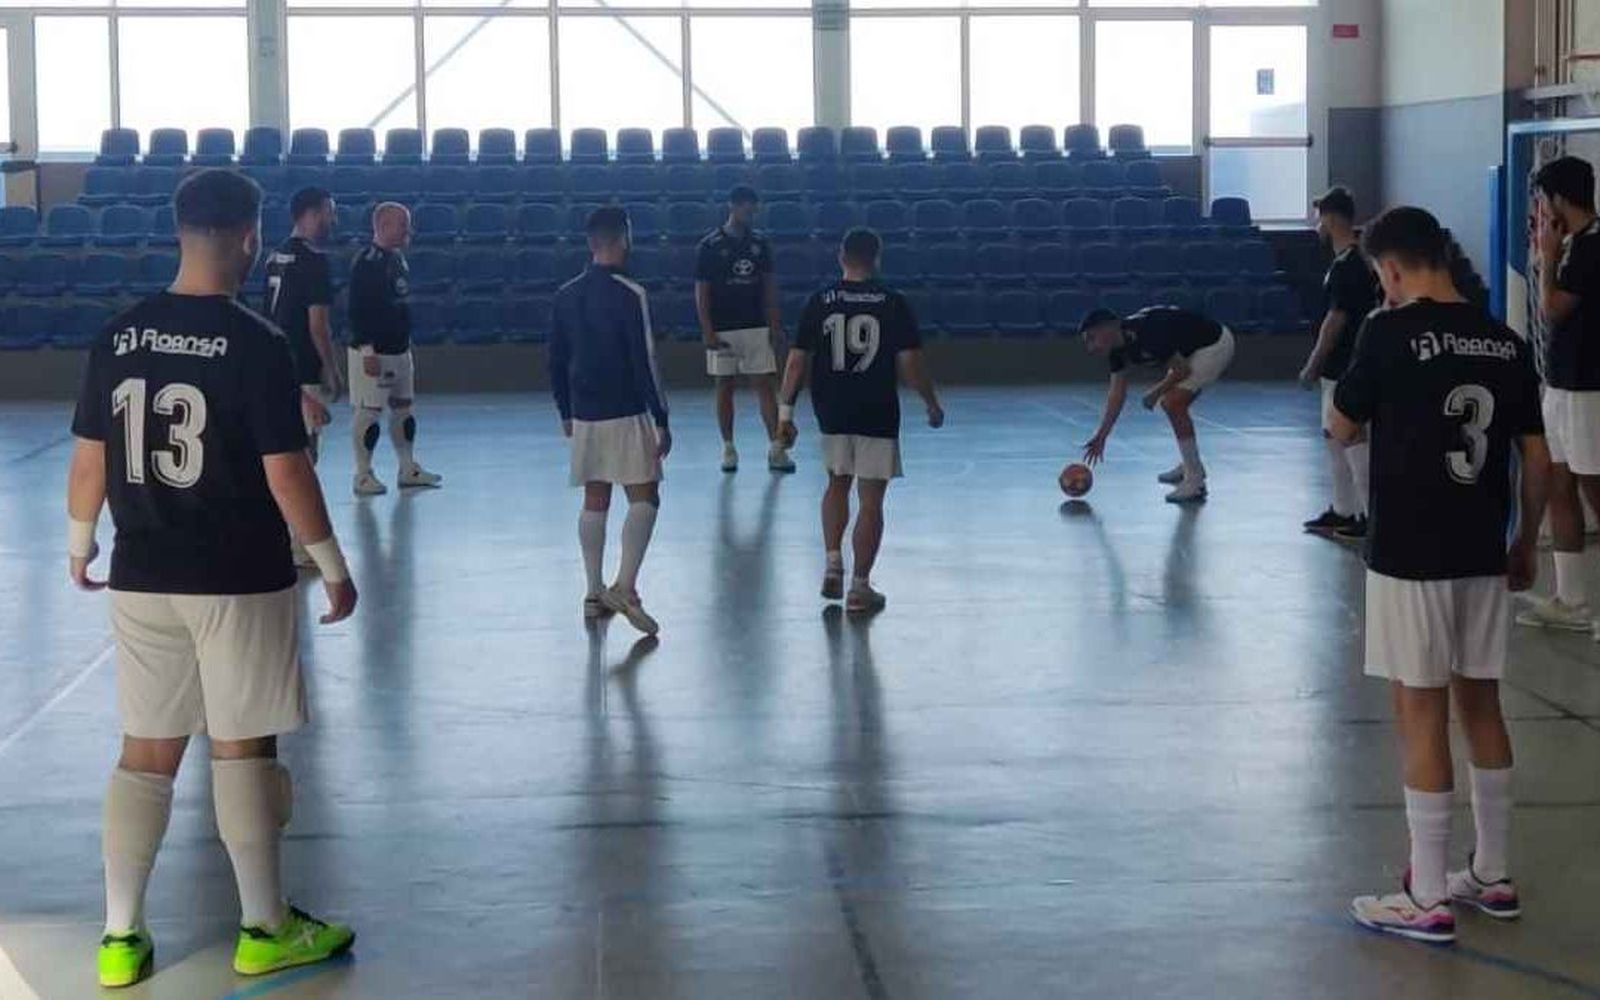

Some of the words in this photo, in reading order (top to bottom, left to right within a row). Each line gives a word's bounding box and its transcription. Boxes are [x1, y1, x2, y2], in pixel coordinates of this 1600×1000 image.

[823, 312, 880, 372] 19
[112, 378, 206, 489] 13
[1444, 385, 1495, 485] 3
